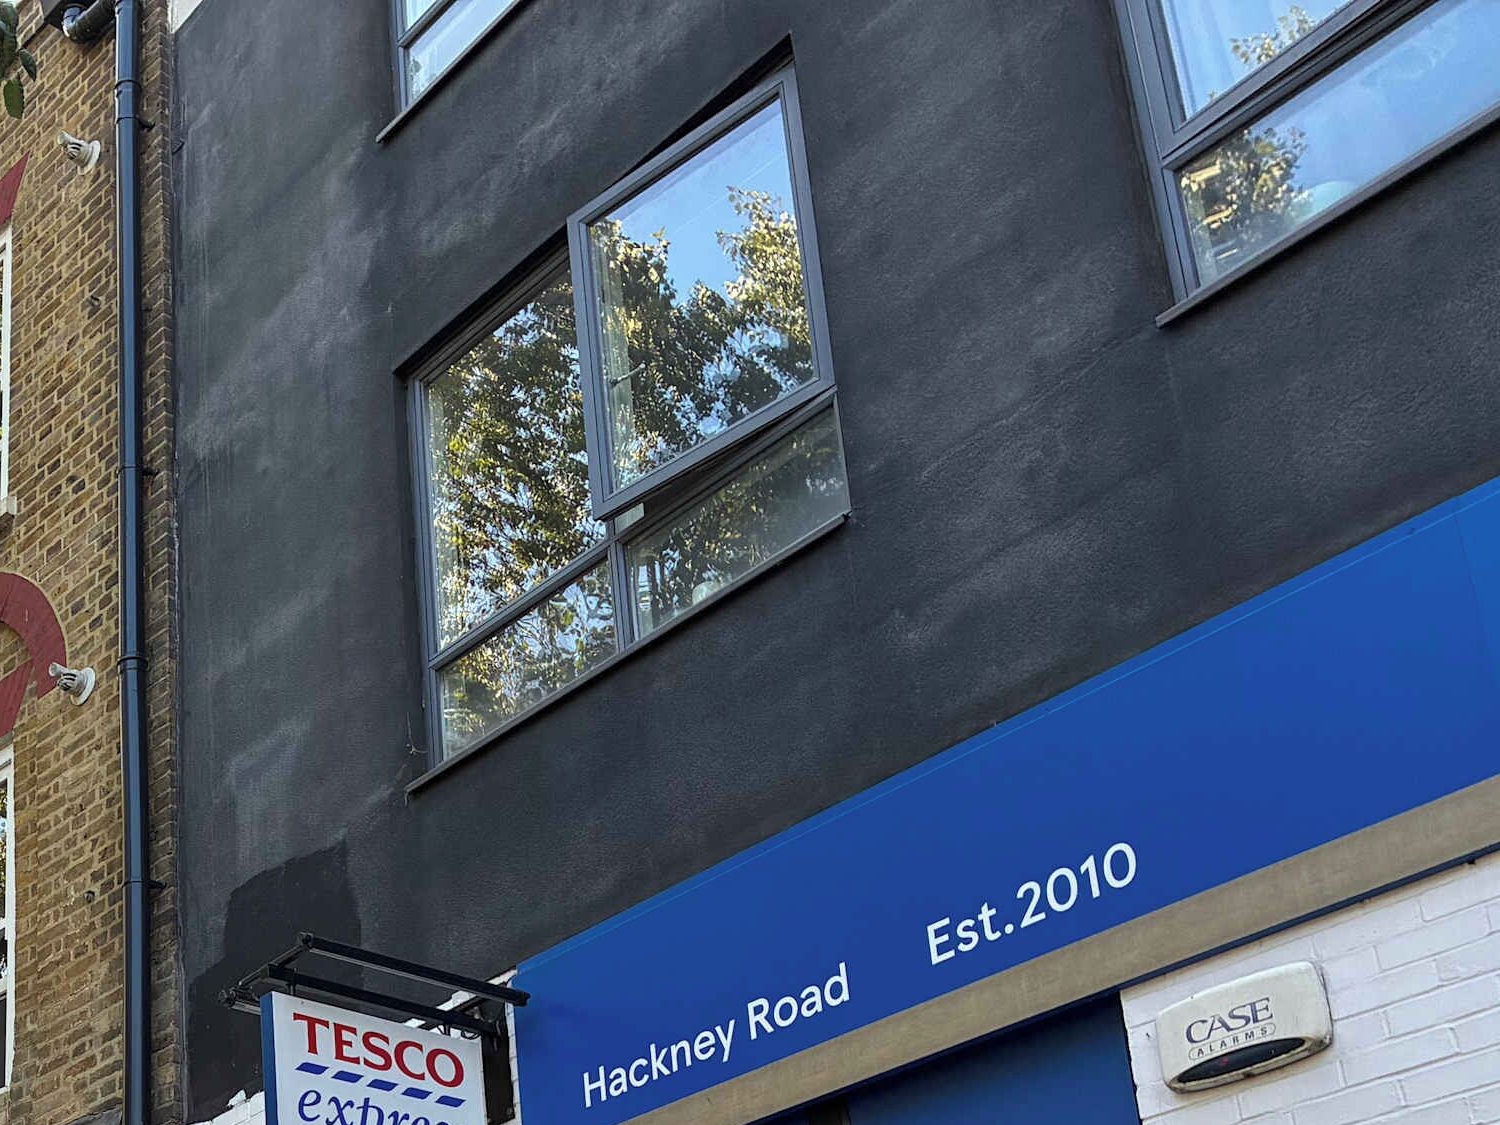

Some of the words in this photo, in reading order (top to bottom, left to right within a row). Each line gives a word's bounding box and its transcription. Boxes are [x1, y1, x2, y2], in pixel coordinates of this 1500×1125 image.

[926, 842, 1137, 966] Est.2010
[293, 1012, 464, 1088] TESCO
[582, 1019, 736, 1108] Hackney
[747, 962, 850, 1040] Road
[1185, 997, 1274, 1044] CASE
[1196, 1026, 1268, 1057] ALARMS
